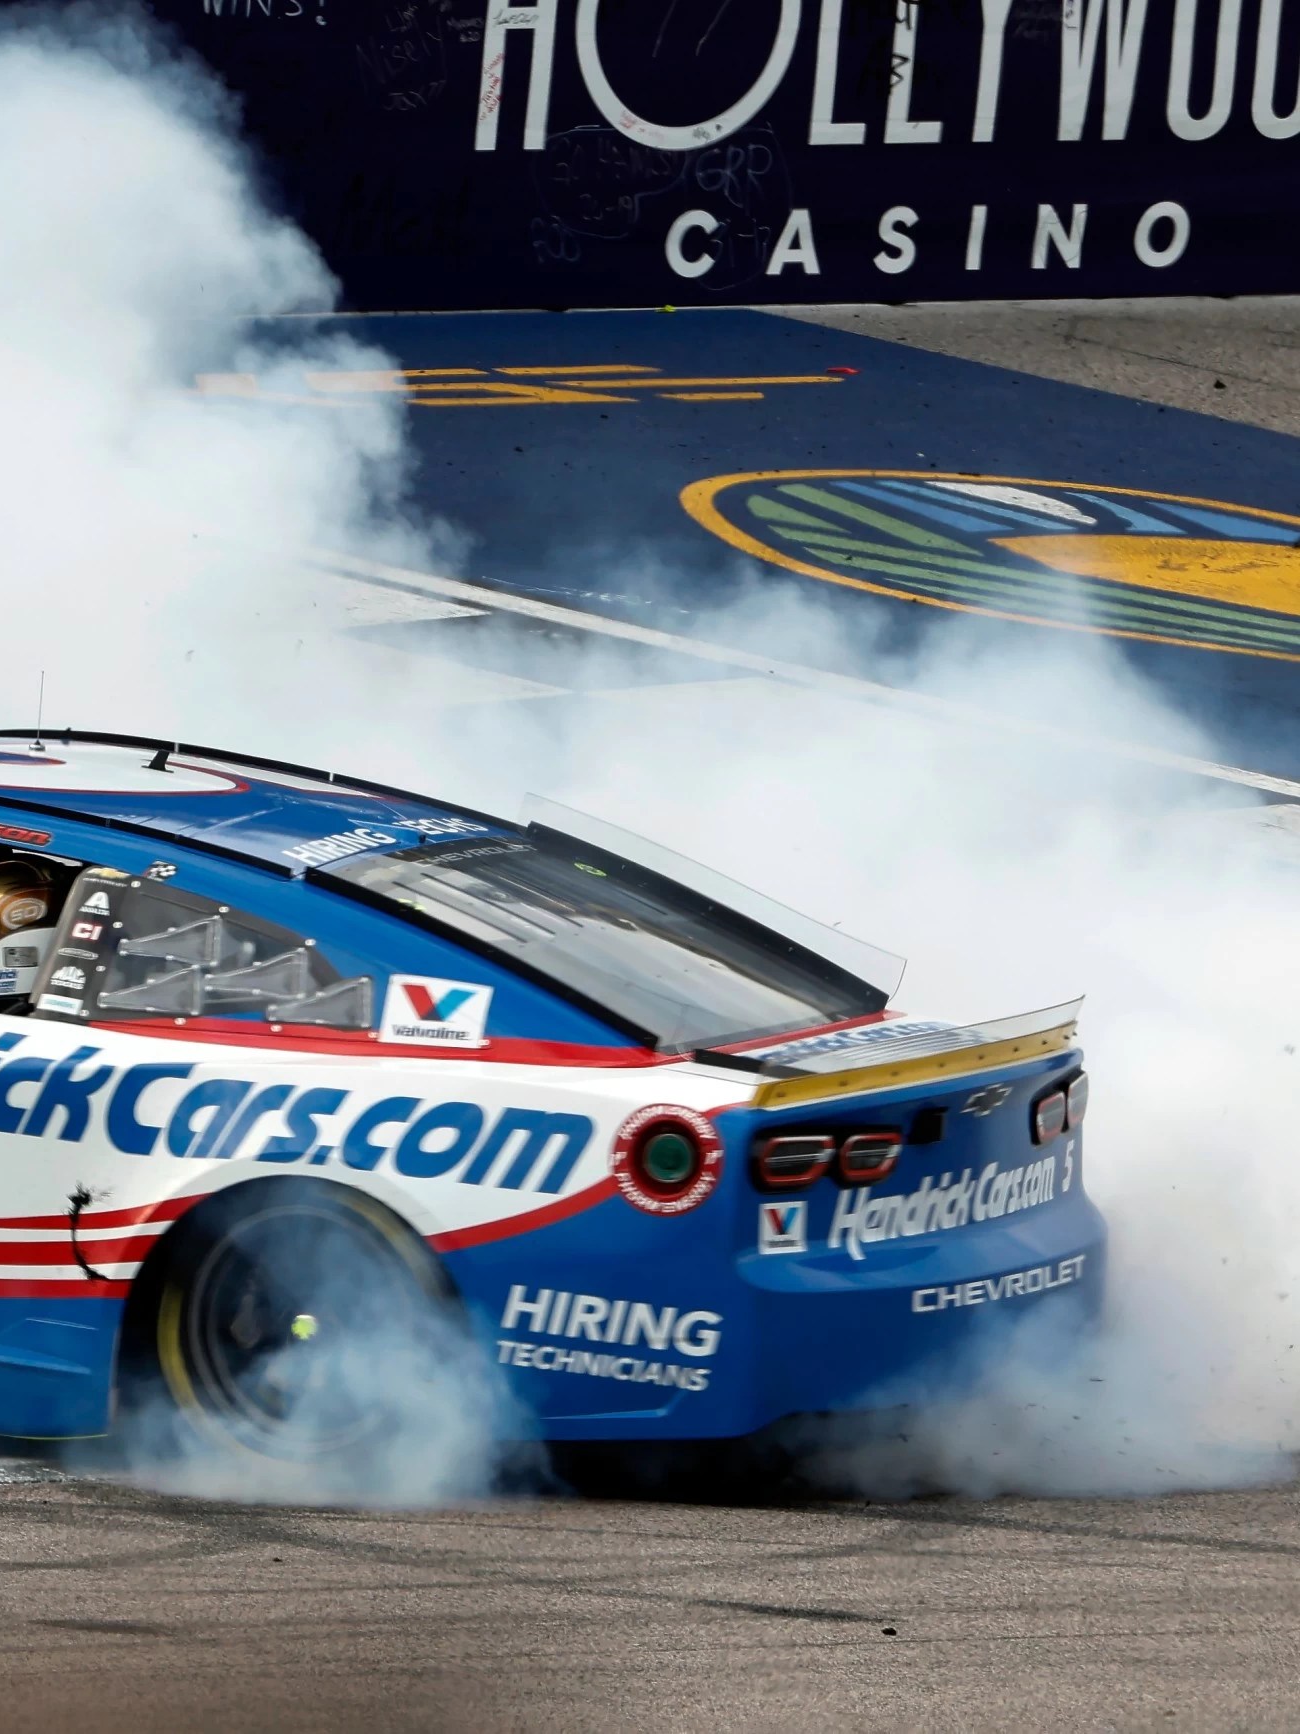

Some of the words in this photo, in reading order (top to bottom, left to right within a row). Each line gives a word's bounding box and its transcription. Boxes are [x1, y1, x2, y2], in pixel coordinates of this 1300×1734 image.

[665, 201, 1191, 279] CASINO
[282, 828, 397, 866] HIRING
[1061, 1141, 1076, 1192] 5
[911, 1254, 1087, 1313] CHEVROLET
[501, 1284, 724, 1357] HIRING
[496, 1340, 712, 1391] TECHNICIANS
